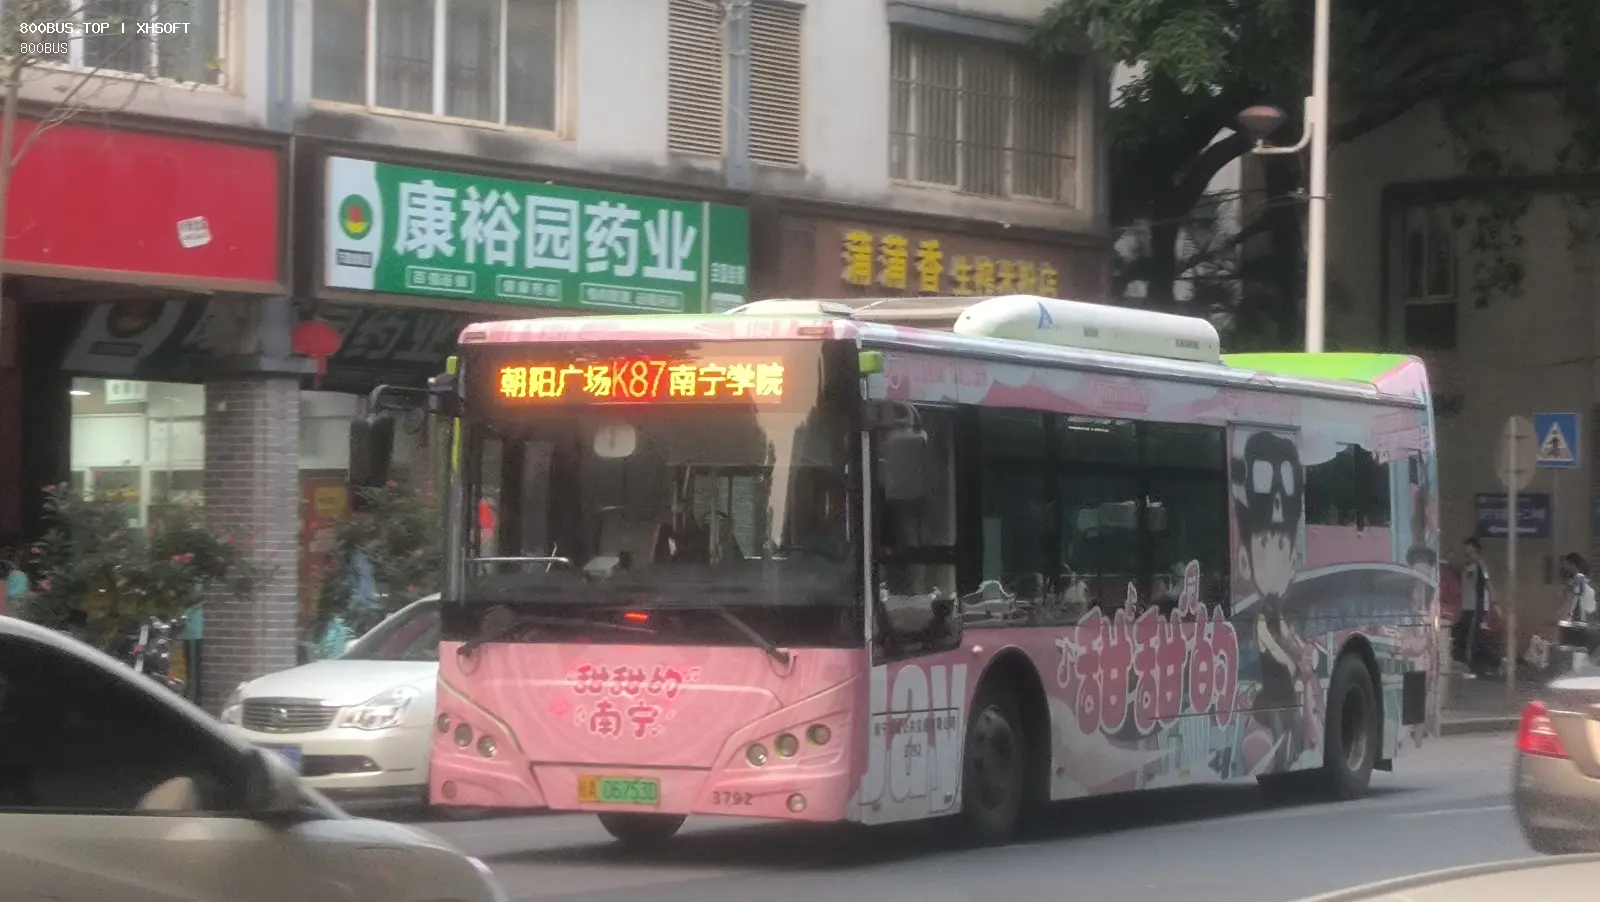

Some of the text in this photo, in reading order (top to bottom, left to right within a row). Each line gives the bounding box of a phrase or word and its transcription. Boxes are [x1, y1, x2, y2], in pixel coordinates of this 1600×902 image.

[393, 179, 697, 283] 康裕园药业
[500, 360, 784, 398] 朝阳广场 K87 南宁学院
[574, 664, 682, 699] 甜甜的
[1074, 601, 1239, 736] 甜甜的
[588, 699, 661, 739] 南宁
[711, 790, 753, 806] 3792
